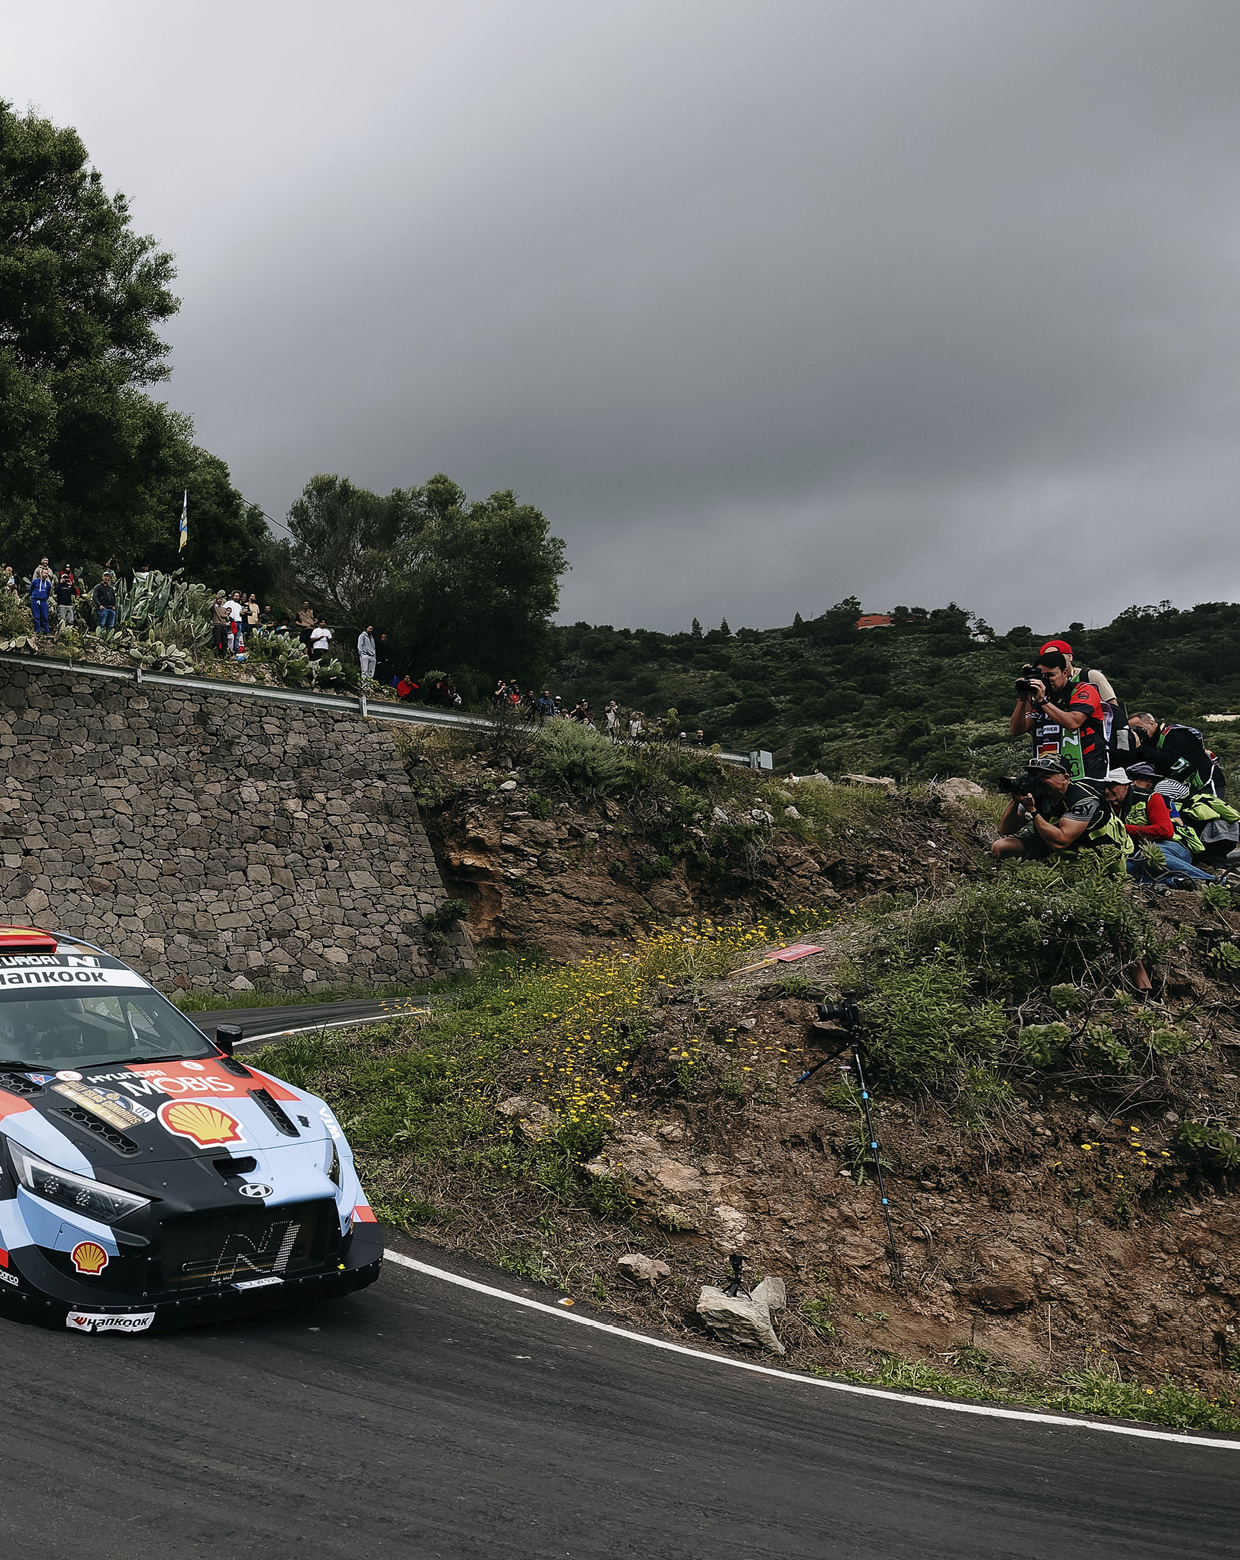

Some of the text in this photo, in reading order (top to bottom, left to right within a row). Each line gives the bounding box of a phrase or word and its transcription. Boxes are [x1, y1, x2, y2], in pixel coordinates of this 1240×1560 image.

[87, 1069, 167, 1084] HYUNDAI
[118, 1076, 235, 1097] MOBIS
[134, 1106, 152, 1118] 06
